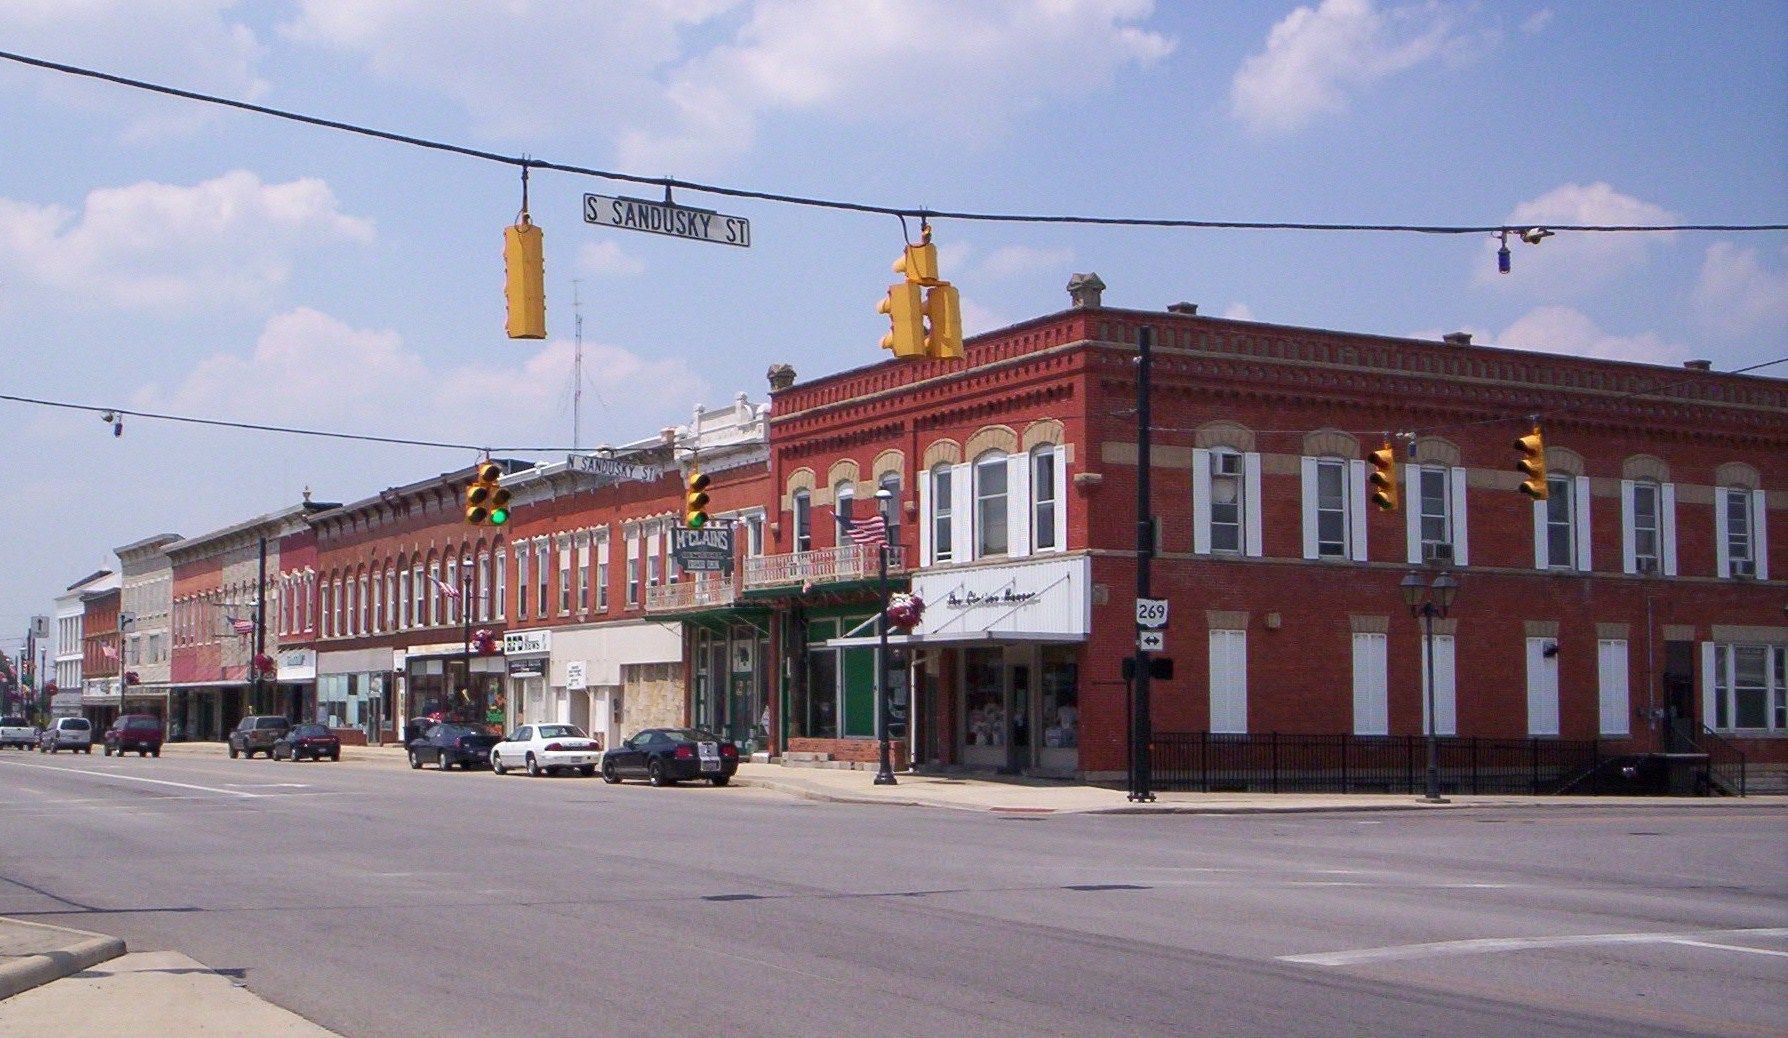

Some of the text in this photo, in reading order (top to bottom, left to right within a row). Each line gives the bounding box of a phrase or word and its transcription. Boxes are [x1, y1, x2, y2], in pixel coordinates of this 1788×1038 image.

[586, 196, 746, 244] S SANDUSKY ST
[568, 454, 655, 480] N SANDUSKY ST
[1138, 604, 1165, 619] 269
